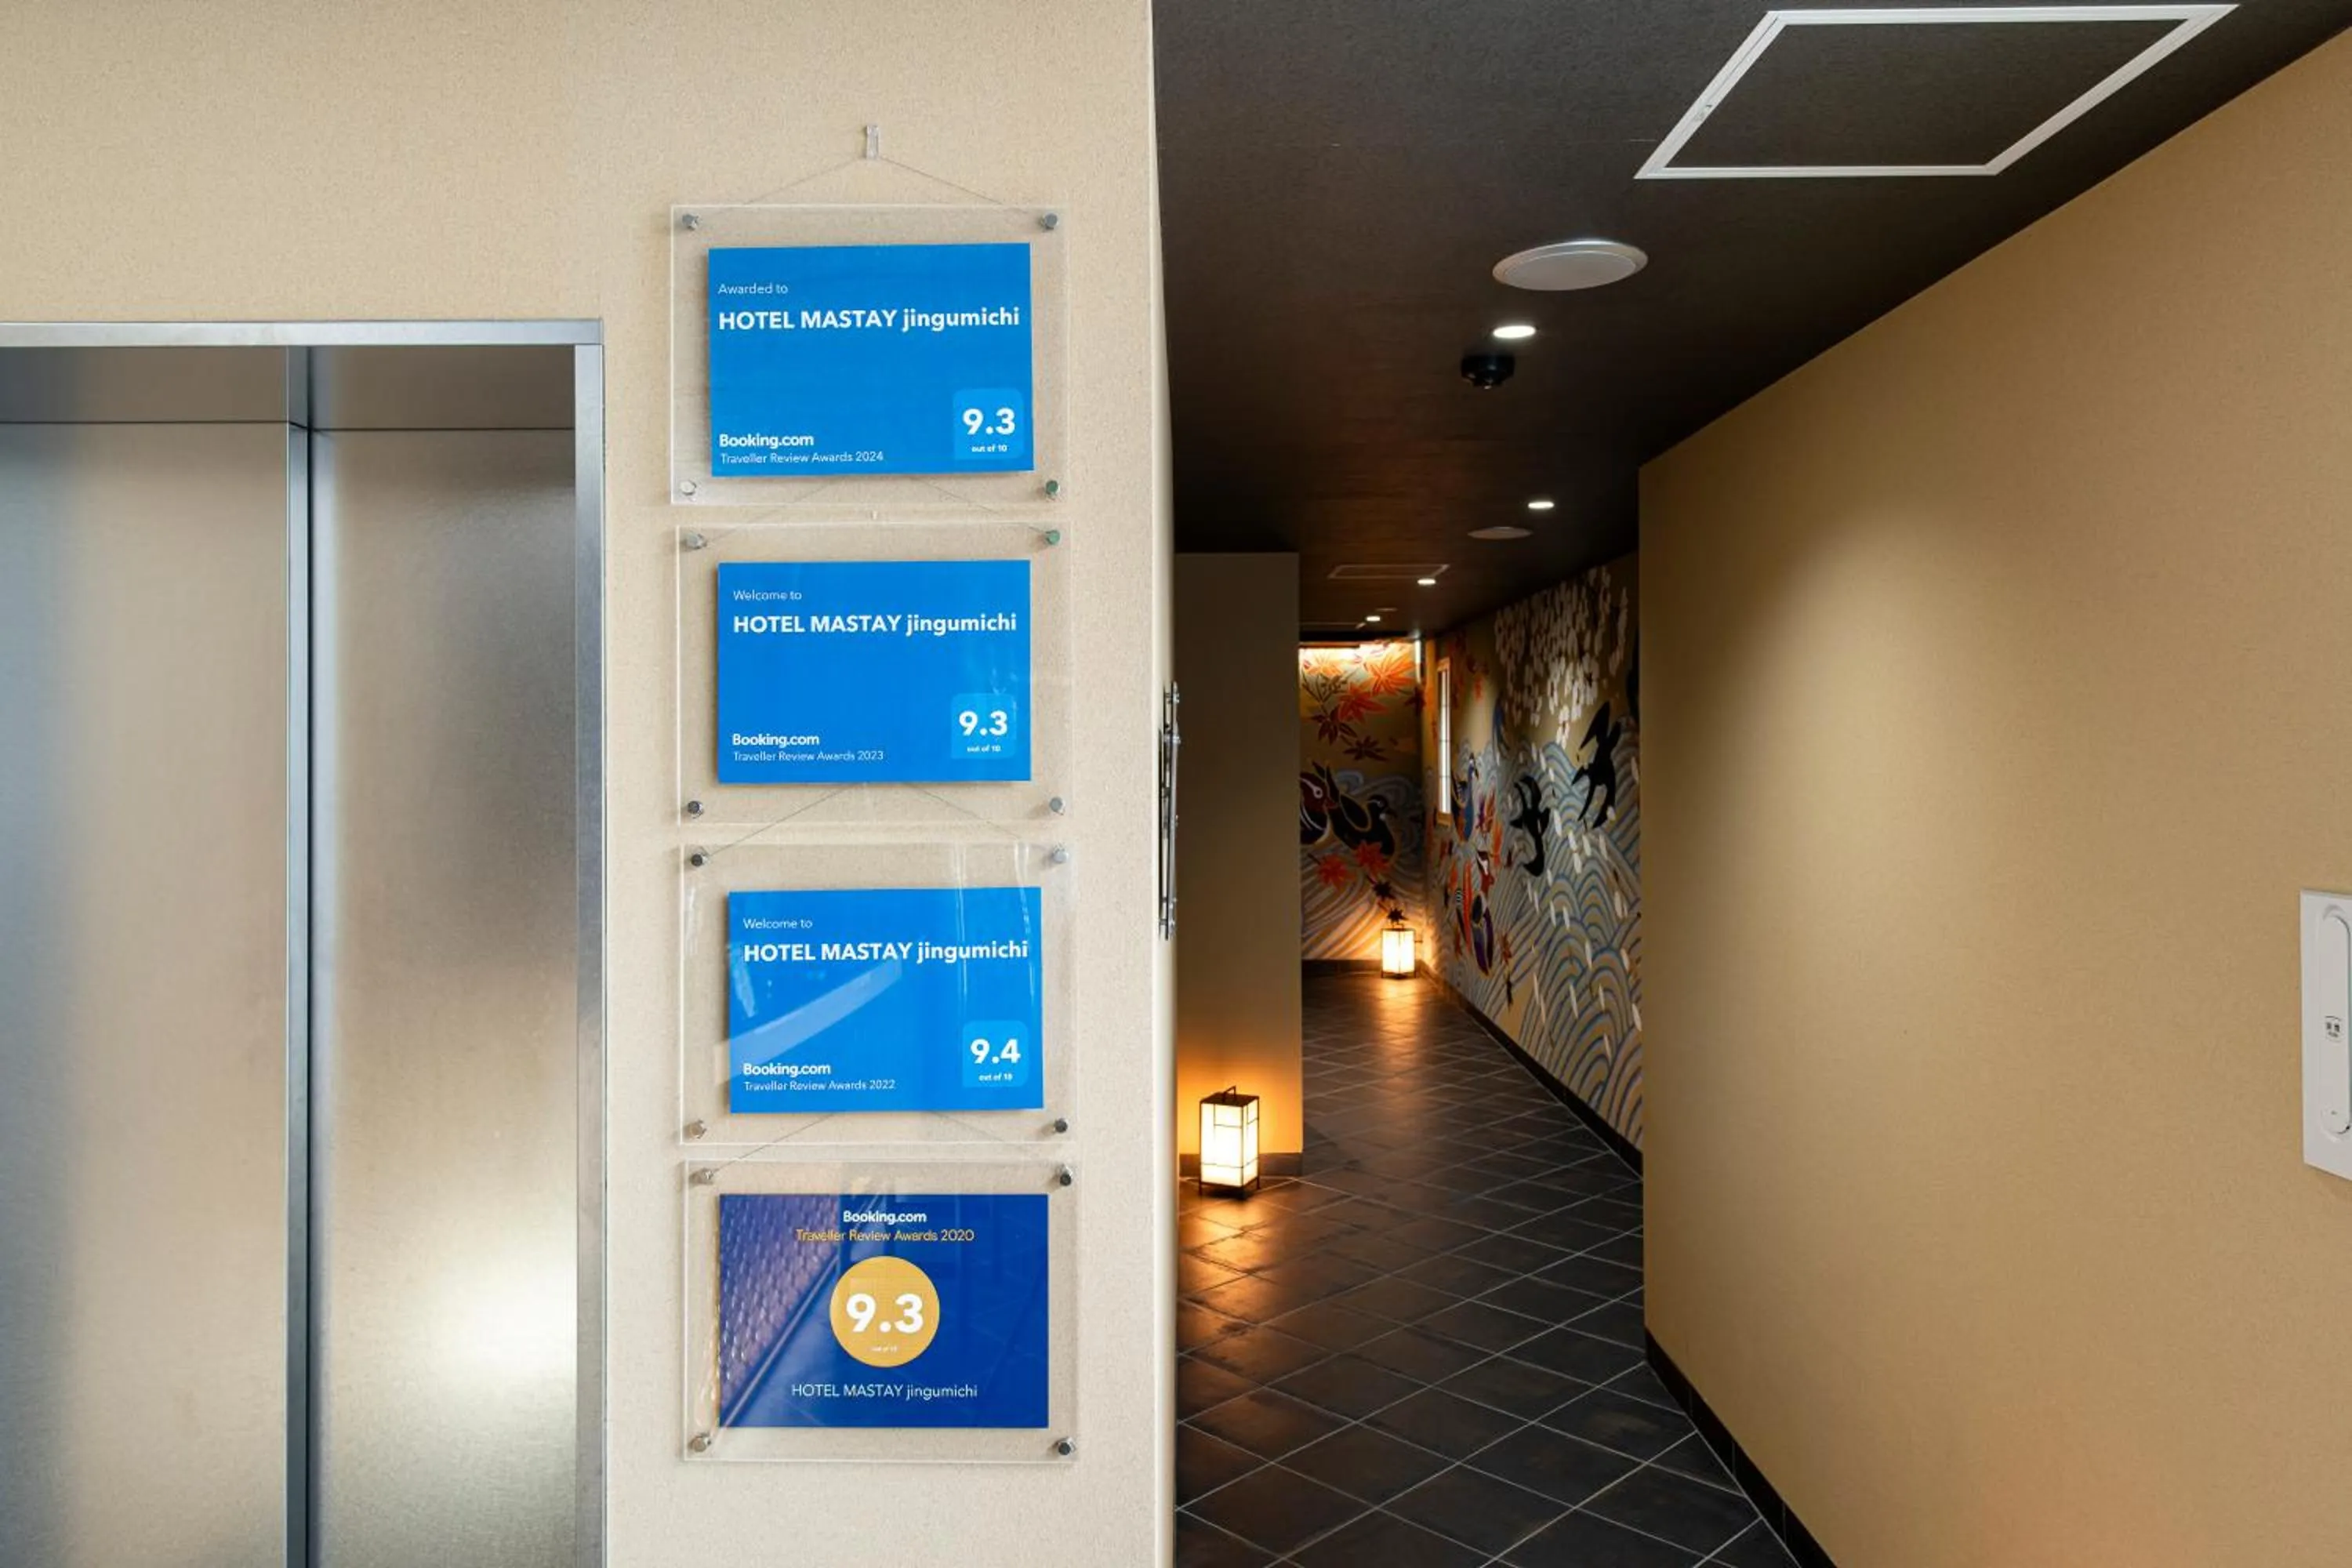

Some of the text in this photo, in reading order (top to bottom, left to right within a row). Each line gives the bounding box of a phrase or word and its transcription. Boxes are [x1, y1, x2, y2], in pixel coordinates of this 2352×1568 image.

[718, 283, 788, 294] Awarded to
[719, 307, 1019, 332] HOTEL MASTAY jingumichi
[962, 408, 1016, 435] 9.3
[720, 434, 814, 448] Booking.com
[720, 451, 884, 465] Traveller Review Awards 2024
[733, 590, 801, 601] Welcome to
[734, 613, 1016, 637] HOTEL MASTAY jingumichi
[958, 710, 1007, 736] 9.3
[732, 734, 819, 748] Booking.com
[734, 751, 884, 761] Traveller Review Awards 2023
[743, 918, 813, 929] Welcome to
[744, 941, 1028, 964] HOTEL MASTAY jingumichi
[970, 1039, 1021, 1064] 9.4
[743, 1063, 831, 1077] Booking.com
[744, 1079, 895, 1091] Traveller Review Awards 2022
[843, 1210, 926, 1225] Booking.com
[796, 1229, 974, 1242] Traveller Review Awards 2020
[846, 1294, 924, 1333] 9.3
[791, 1384, 978, 1400] HOTEL MASTAY jingumichi
